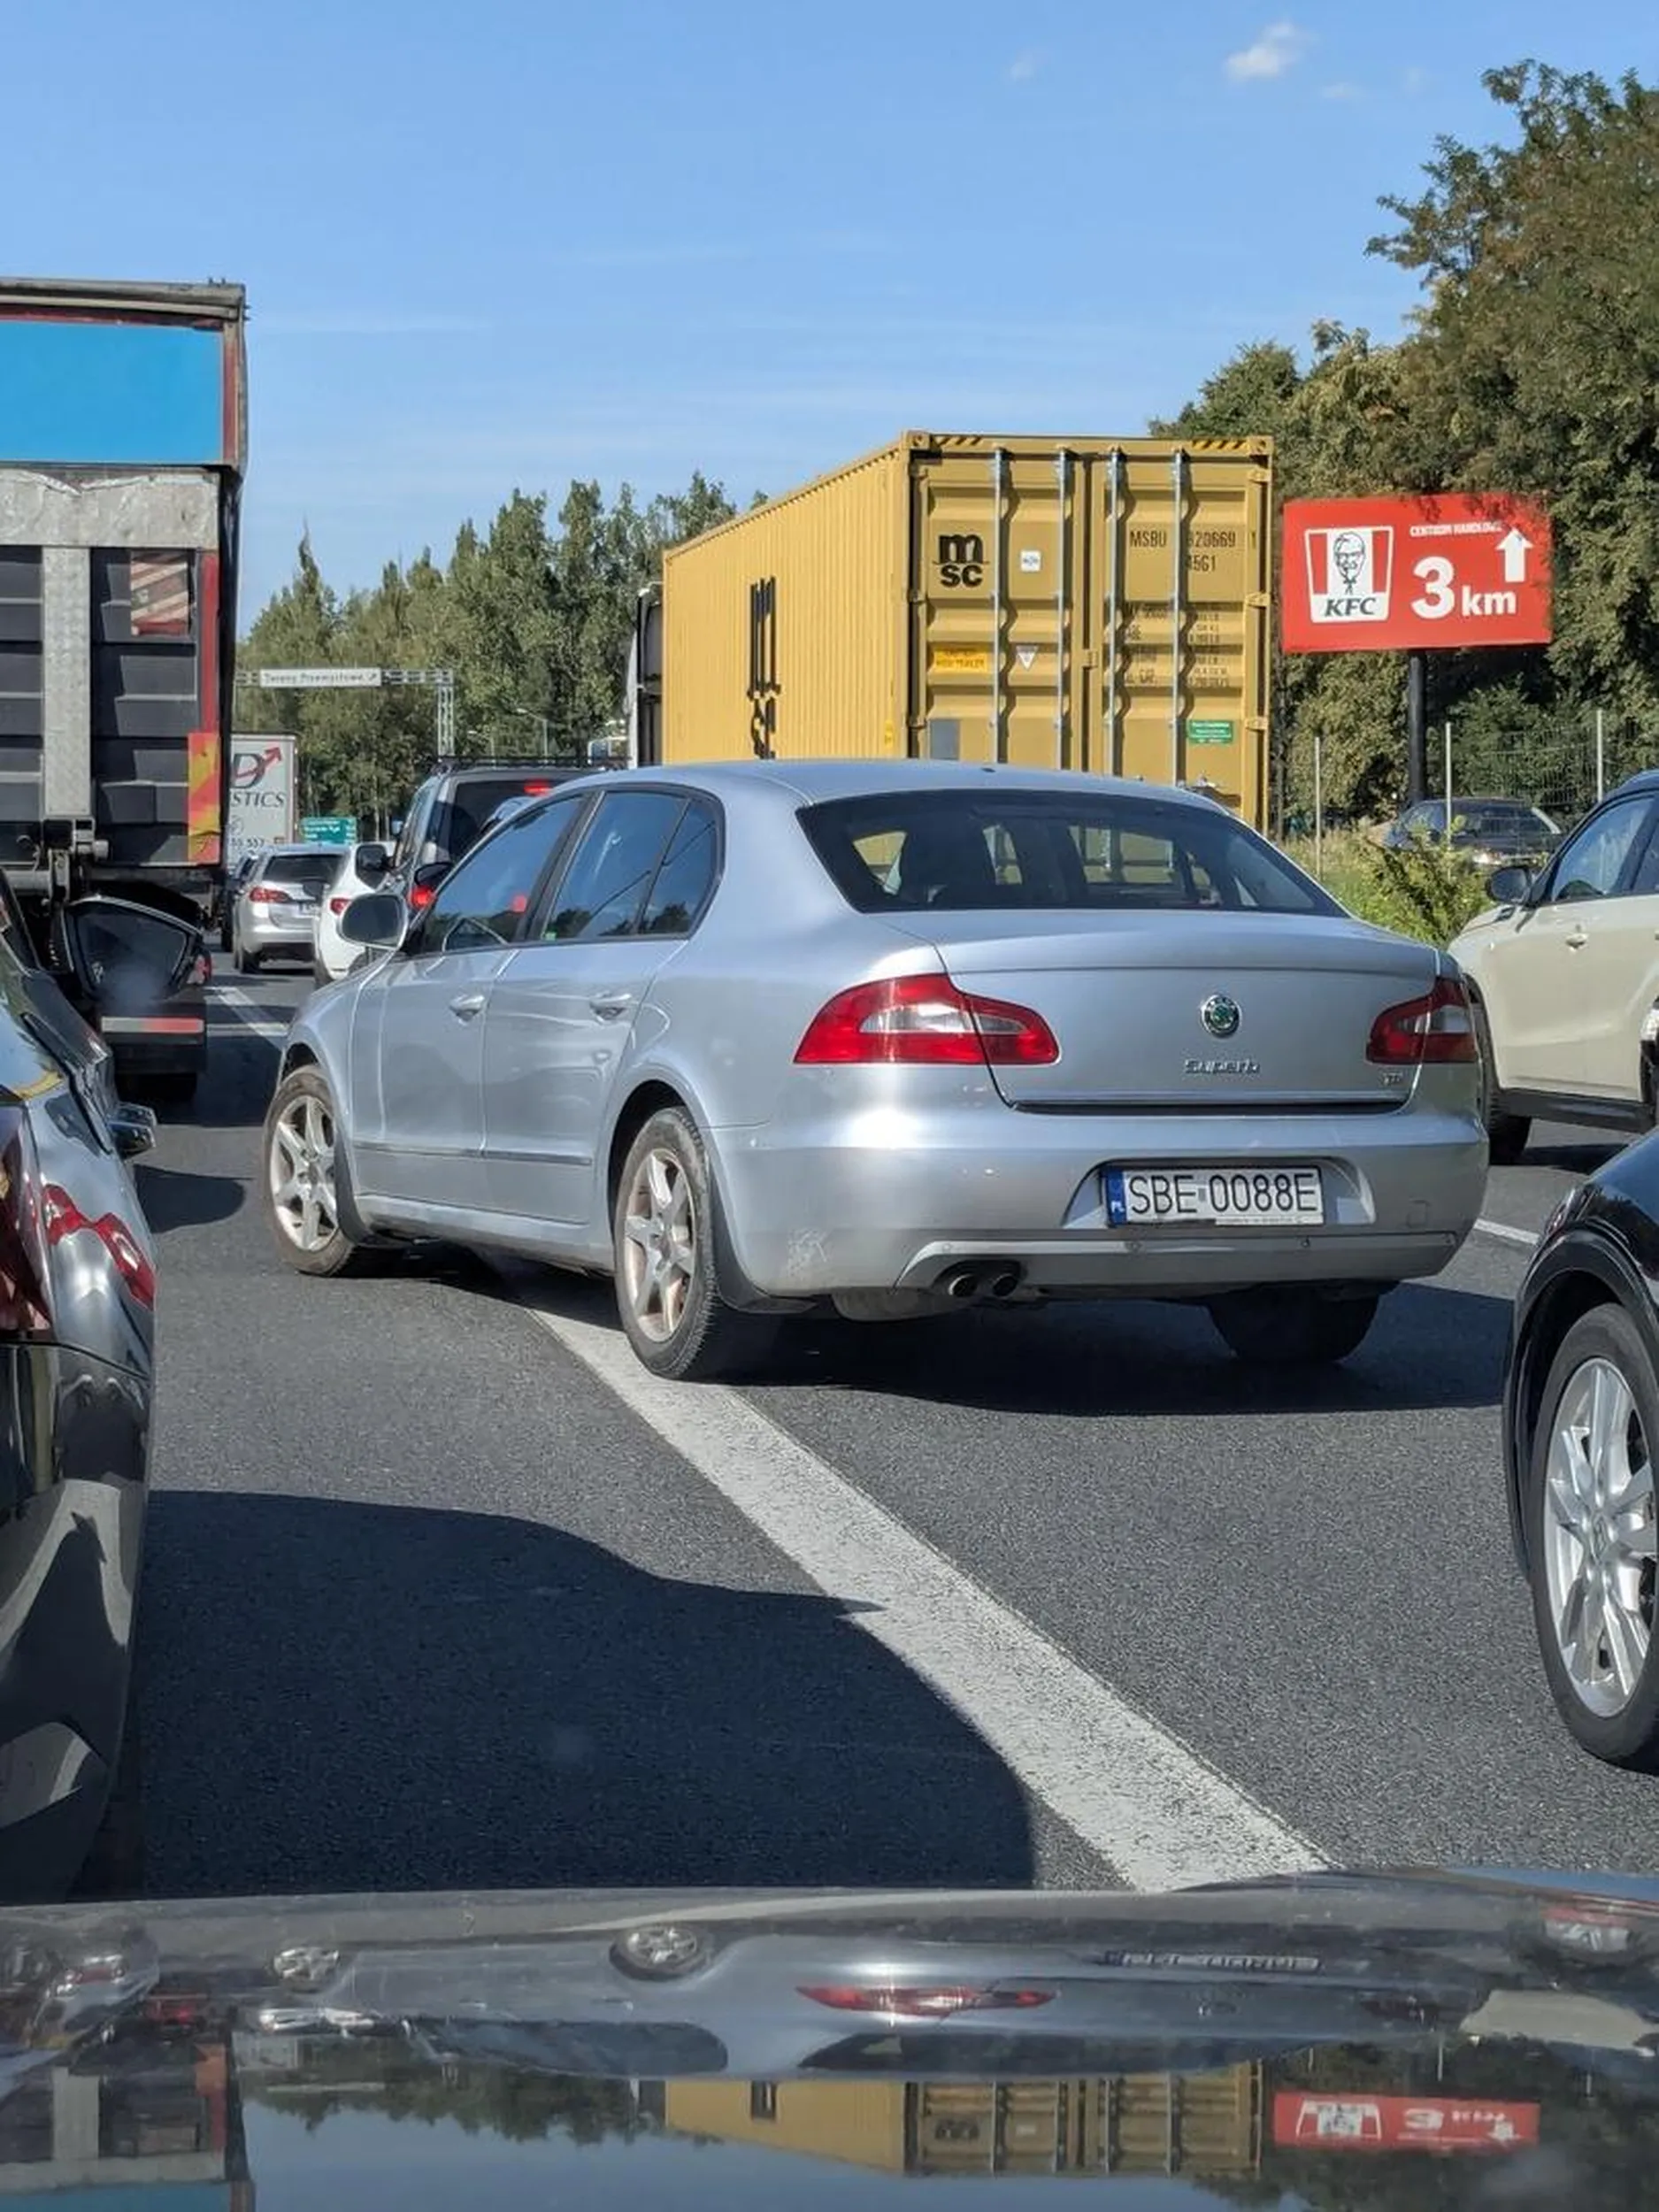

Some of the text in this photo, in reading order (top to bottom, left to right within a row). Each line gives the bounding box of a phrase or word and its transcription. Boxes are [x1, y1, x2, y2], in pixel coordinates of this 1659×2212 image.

[1411, 556, 1517, 619] 3 km
[1325, 596, 1377, 618] KFC
[1185, 1058, 1260, 1075] Superb
[1128, 1172, 1317, 1215] SBE 0088E
